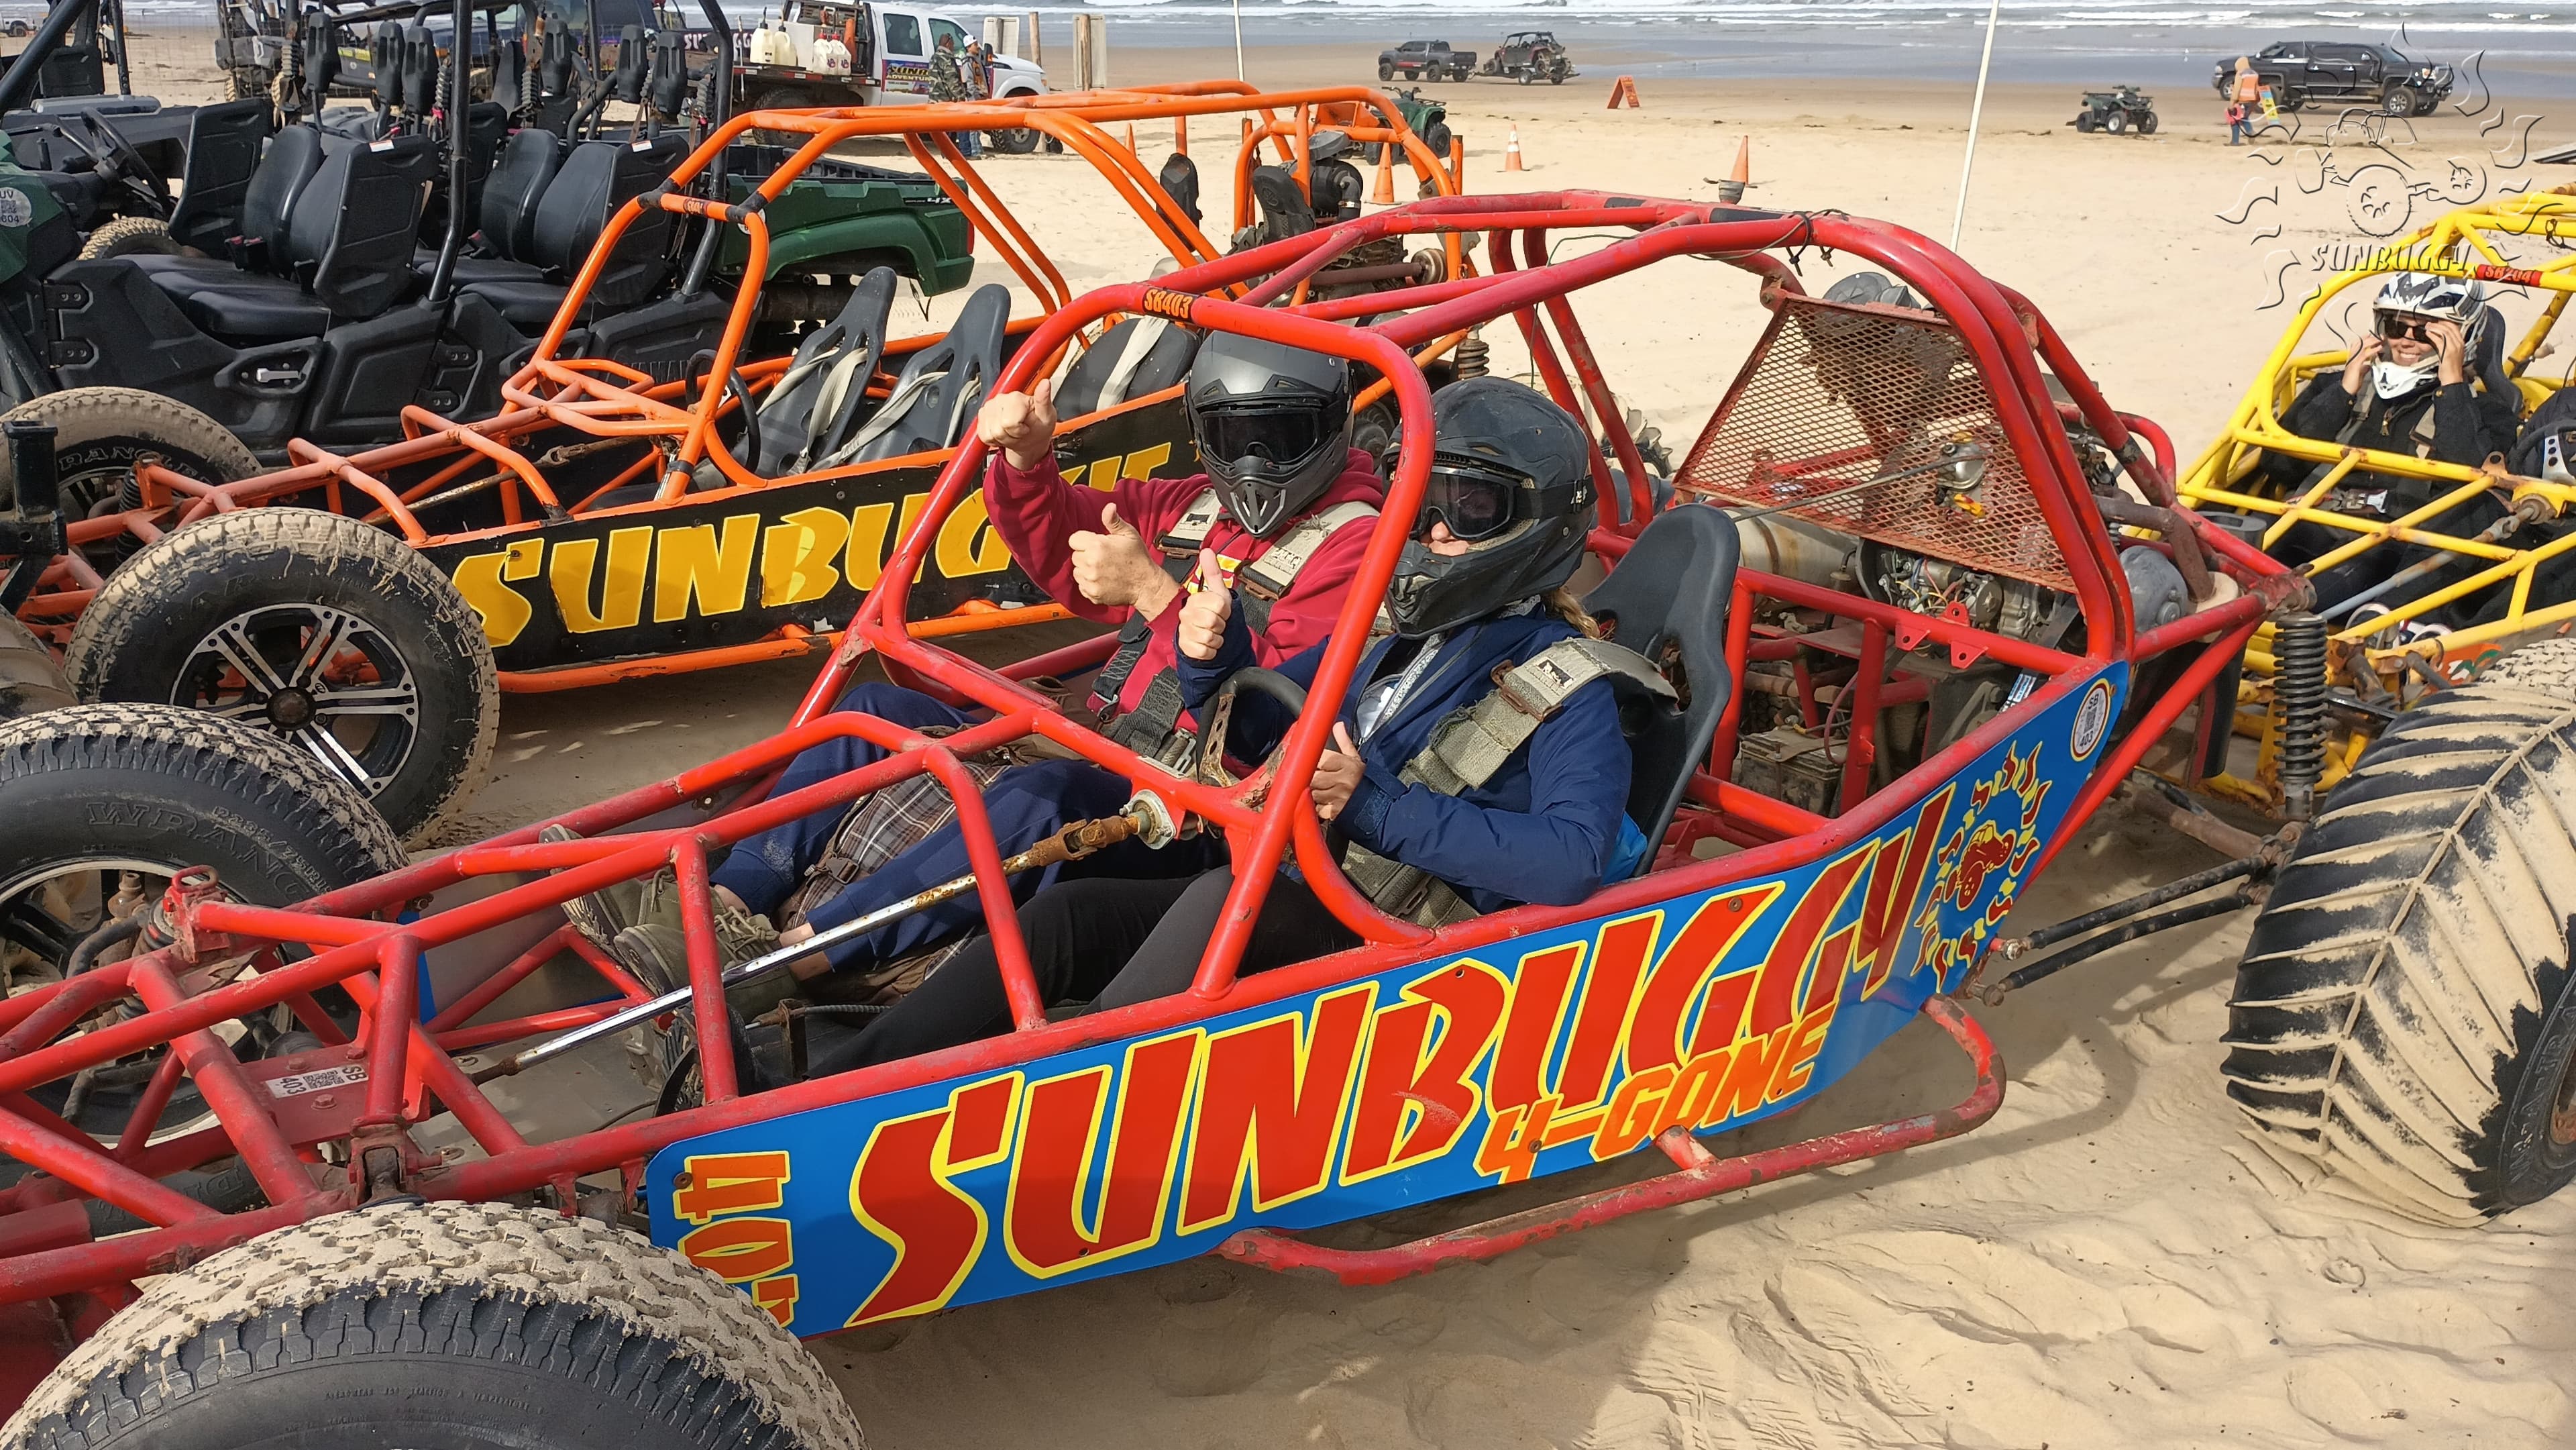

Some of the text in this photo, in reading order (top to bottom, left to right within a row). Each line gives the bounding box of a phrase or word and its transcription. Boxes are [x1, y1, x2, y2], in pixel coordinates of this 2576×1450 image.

[2485, 266, 2534, 283] SB204
[1144, 289, 1193, 319] SB403
[453, 442, 1171, 648] SUNBUG
[2088, 693, 2099, 710] SB
[2080, 730, 2094, 747] 403
[843, 782, 1955, 1328] SUNBUGGY
[342, 1066, 367, 1082] SB
[280, 1077, 307, 1095] 403
[1474, 998, 1839, 1184] 4-GONE
